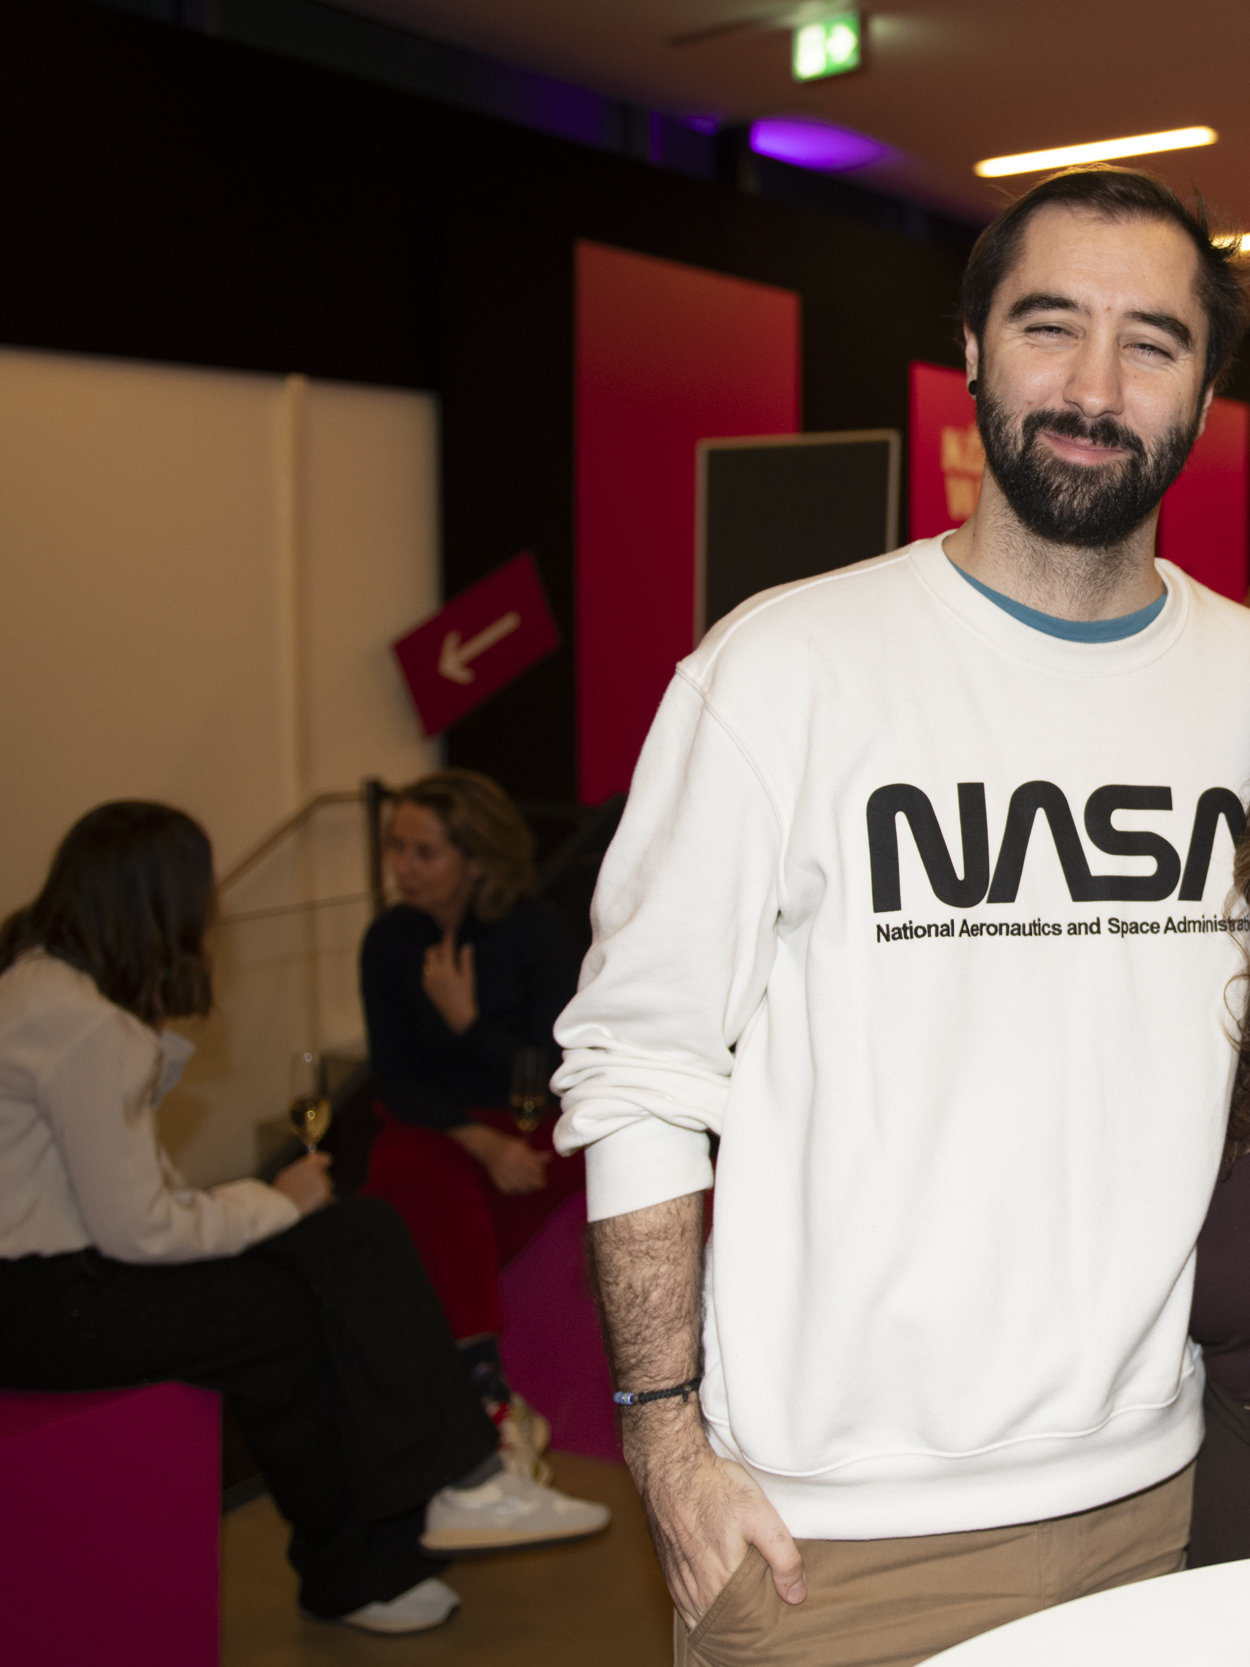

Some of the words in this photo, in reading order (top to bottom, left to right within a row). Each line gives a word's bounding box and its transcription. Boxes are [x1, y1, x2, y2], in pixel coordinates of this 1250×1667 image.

[866, 780, 1247, 913] NASA
[876, 918, 955, 943] National
[958, 918, 1062, 938] Aeronautics
[1067, 917, 1101, 936] and
[1107, 917, 1160, 938] Space
